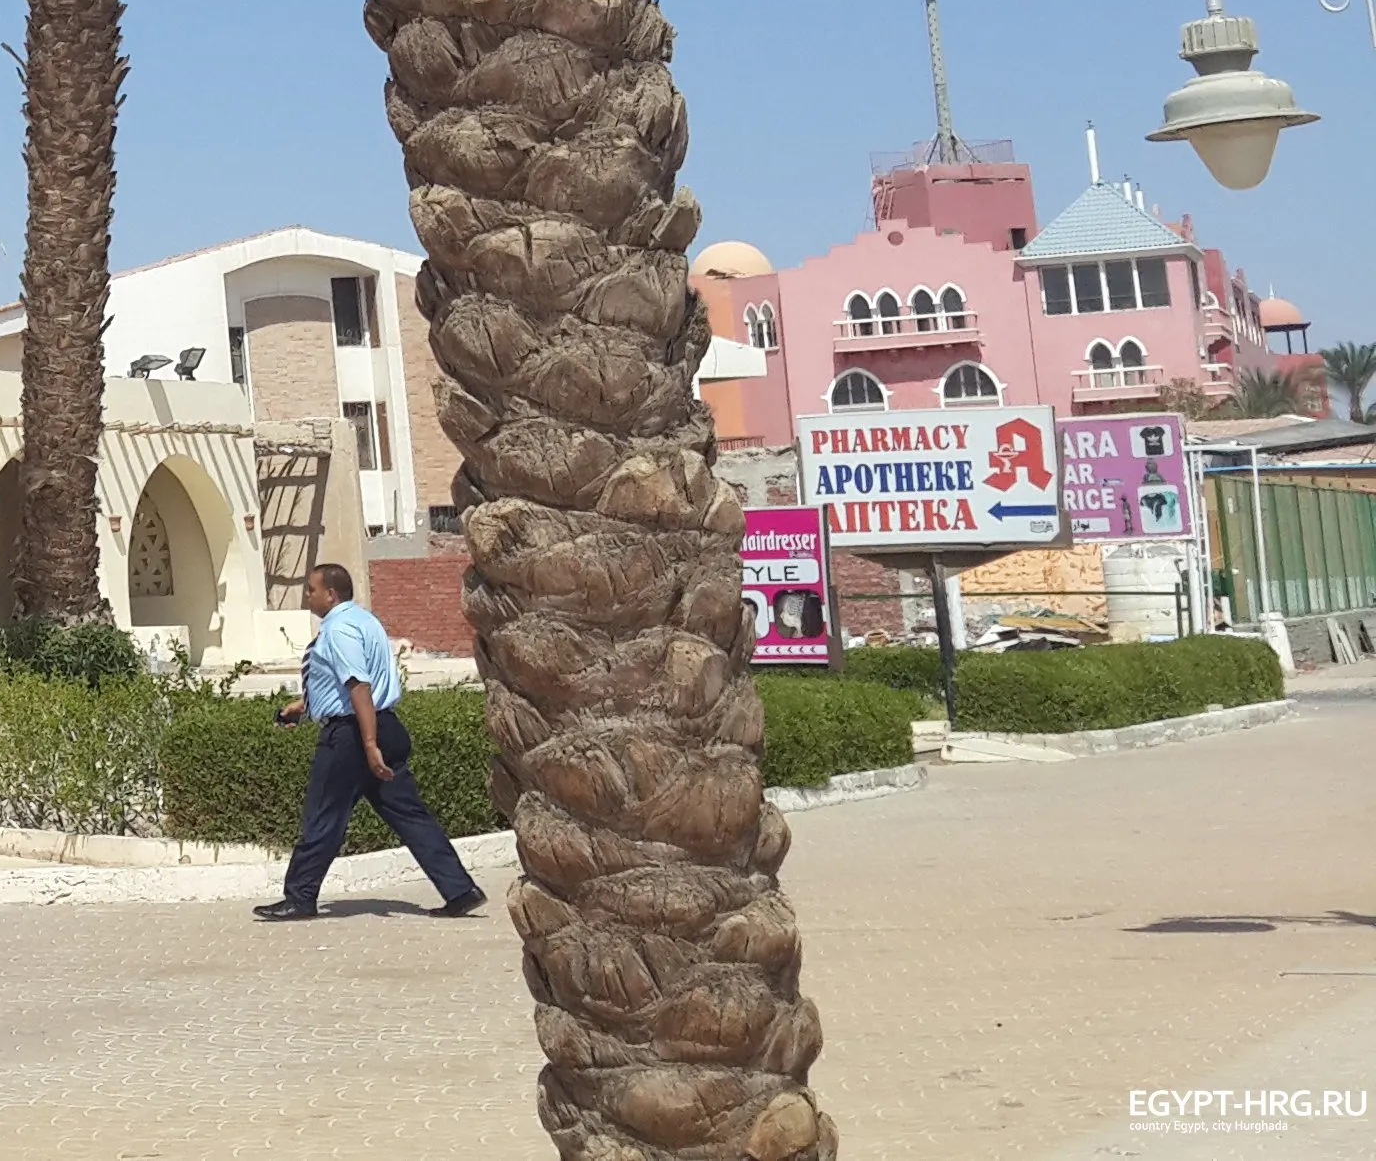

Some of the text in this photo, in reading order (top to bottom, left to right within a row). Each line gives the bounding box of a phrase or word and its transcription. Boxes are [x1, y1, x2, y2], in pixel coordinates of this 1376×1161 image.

[810, 424, 970, 455] PHARMACY
[1064, 430, 1119, 459] ARA
[815, 460, 974, 496] APOTHEKE
[1064, 463, 1095, 485] AR
[1063, 488, 1117, 511] RICE
[742, 565, 800, 582] TYLE
